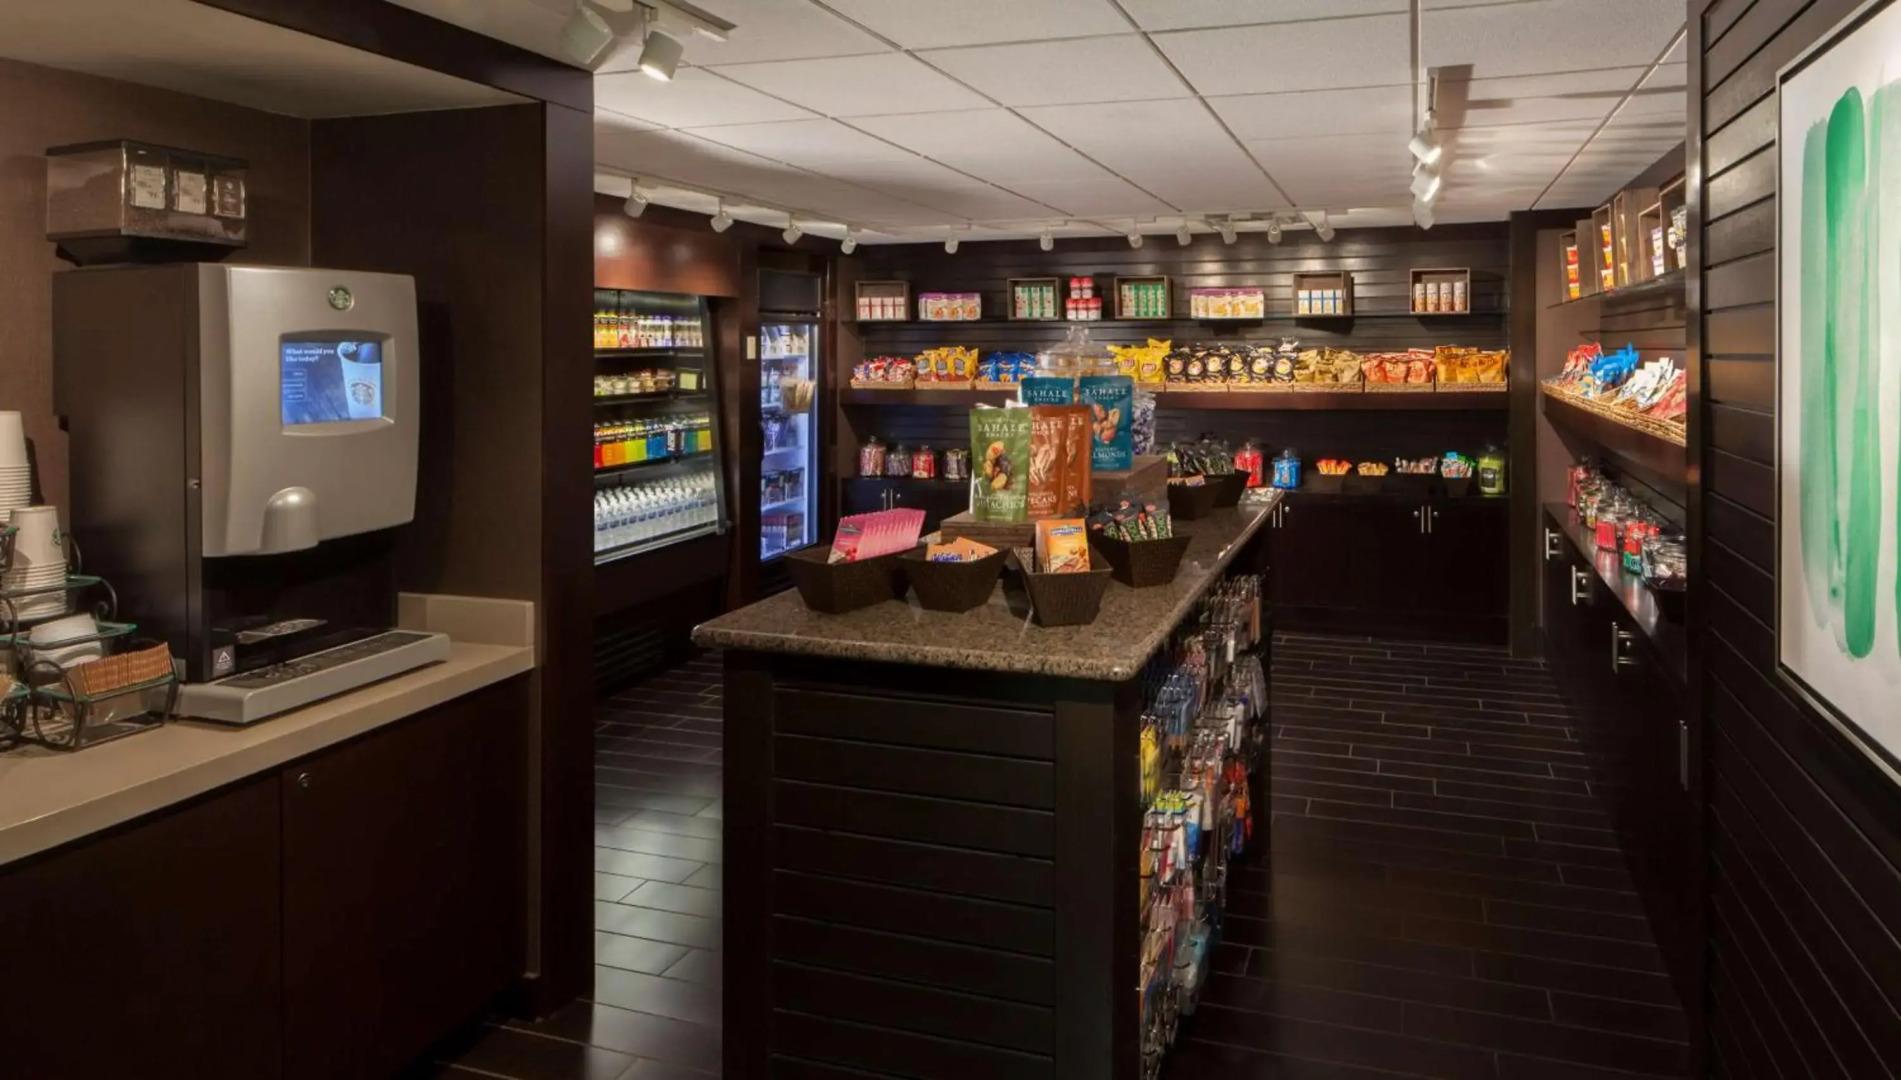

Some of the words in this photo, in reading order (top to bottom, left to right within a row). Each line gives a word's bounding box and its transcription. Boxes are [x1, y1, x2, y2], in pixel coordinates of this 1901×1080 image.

[1027, 390, 1068, 398] SAHALE
[1085, 387, 1126, 396] SAHALE
[977, 423, 1028, 432] SAHALE
[1032, 419, 1063, 430] HALE
